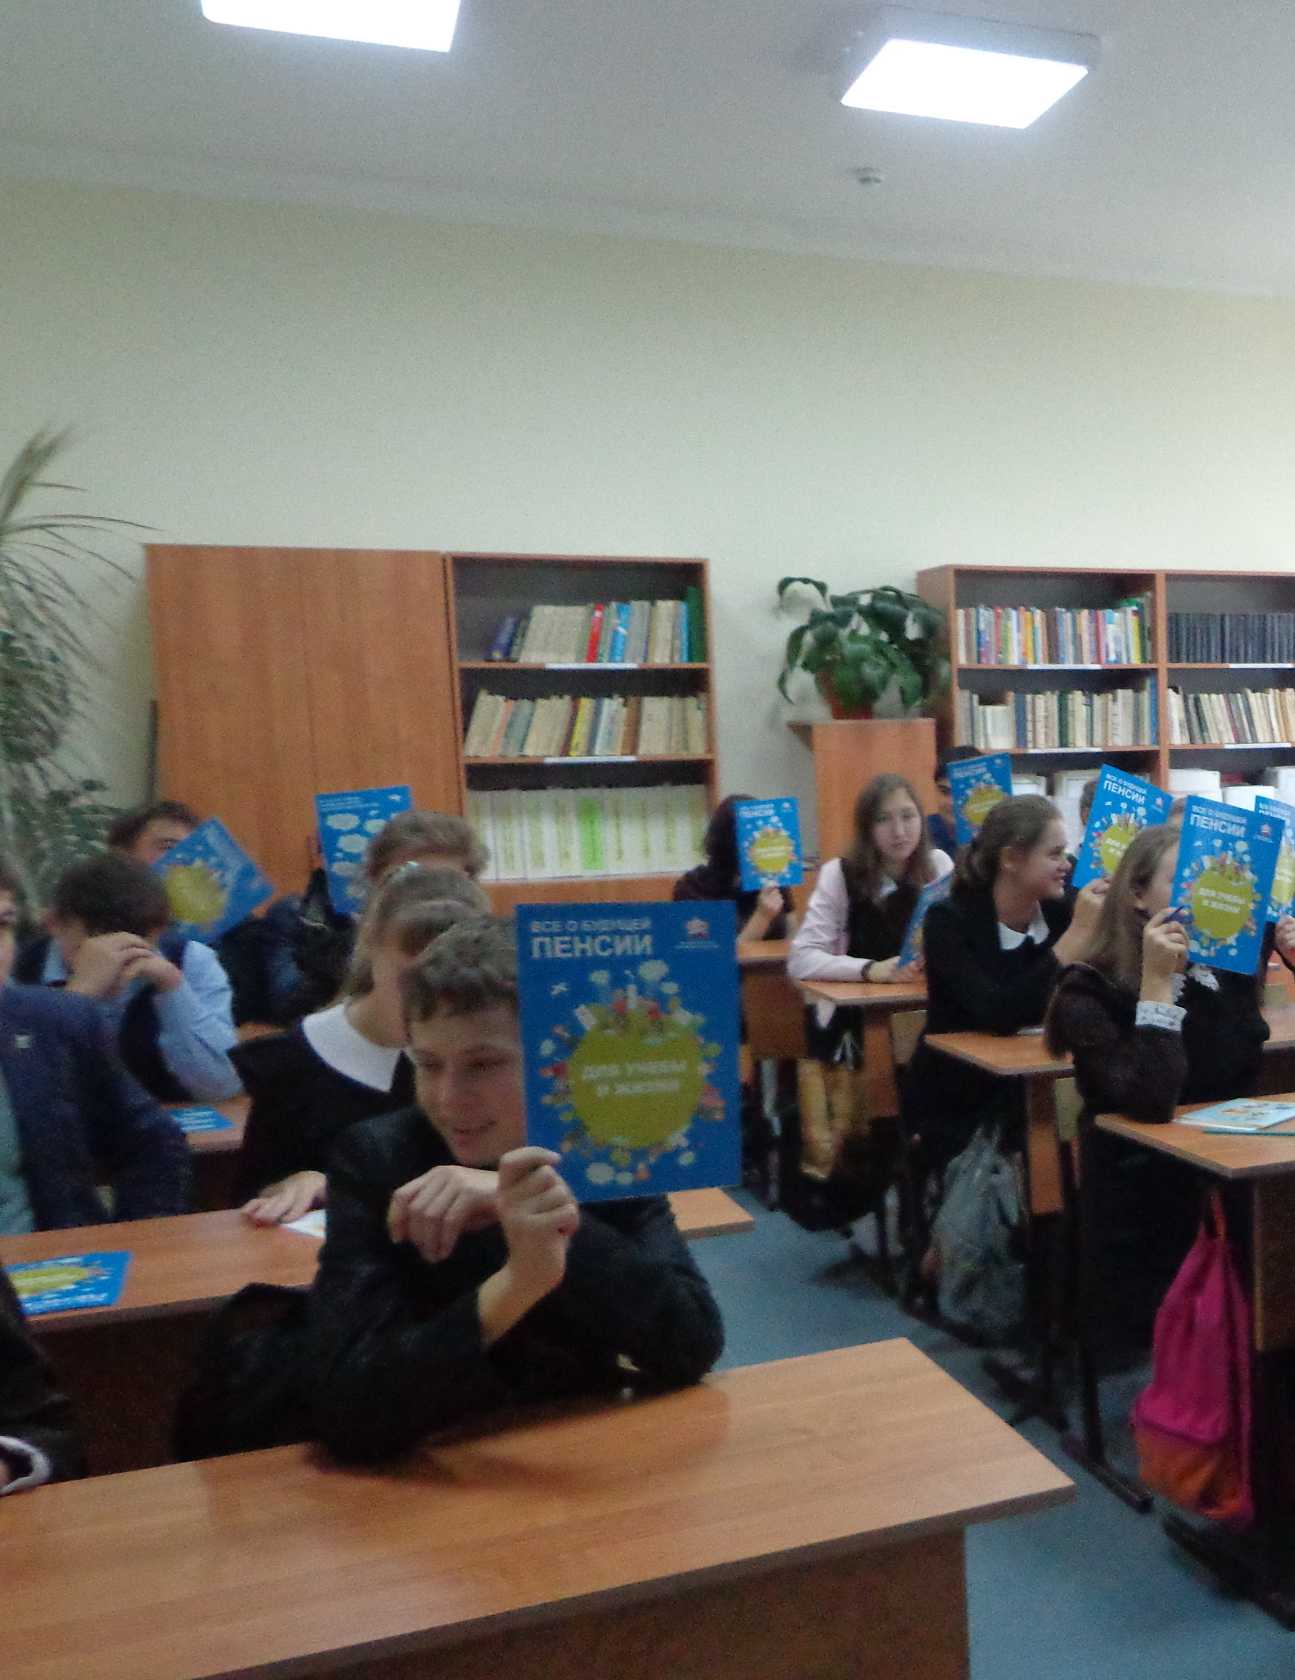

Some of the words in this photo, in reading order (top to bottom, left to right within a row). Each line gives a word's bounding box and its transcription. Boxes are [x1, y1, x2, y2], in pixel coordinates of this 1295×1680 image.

[1103, 780, 1145, 805] ПЕНСИИ
[1189, 813, 1247, 838] ПЕНСИИ
[530, 920, 562, 933] ВСЕ
[531, 934, 653, 958] ПЕНСИИ
